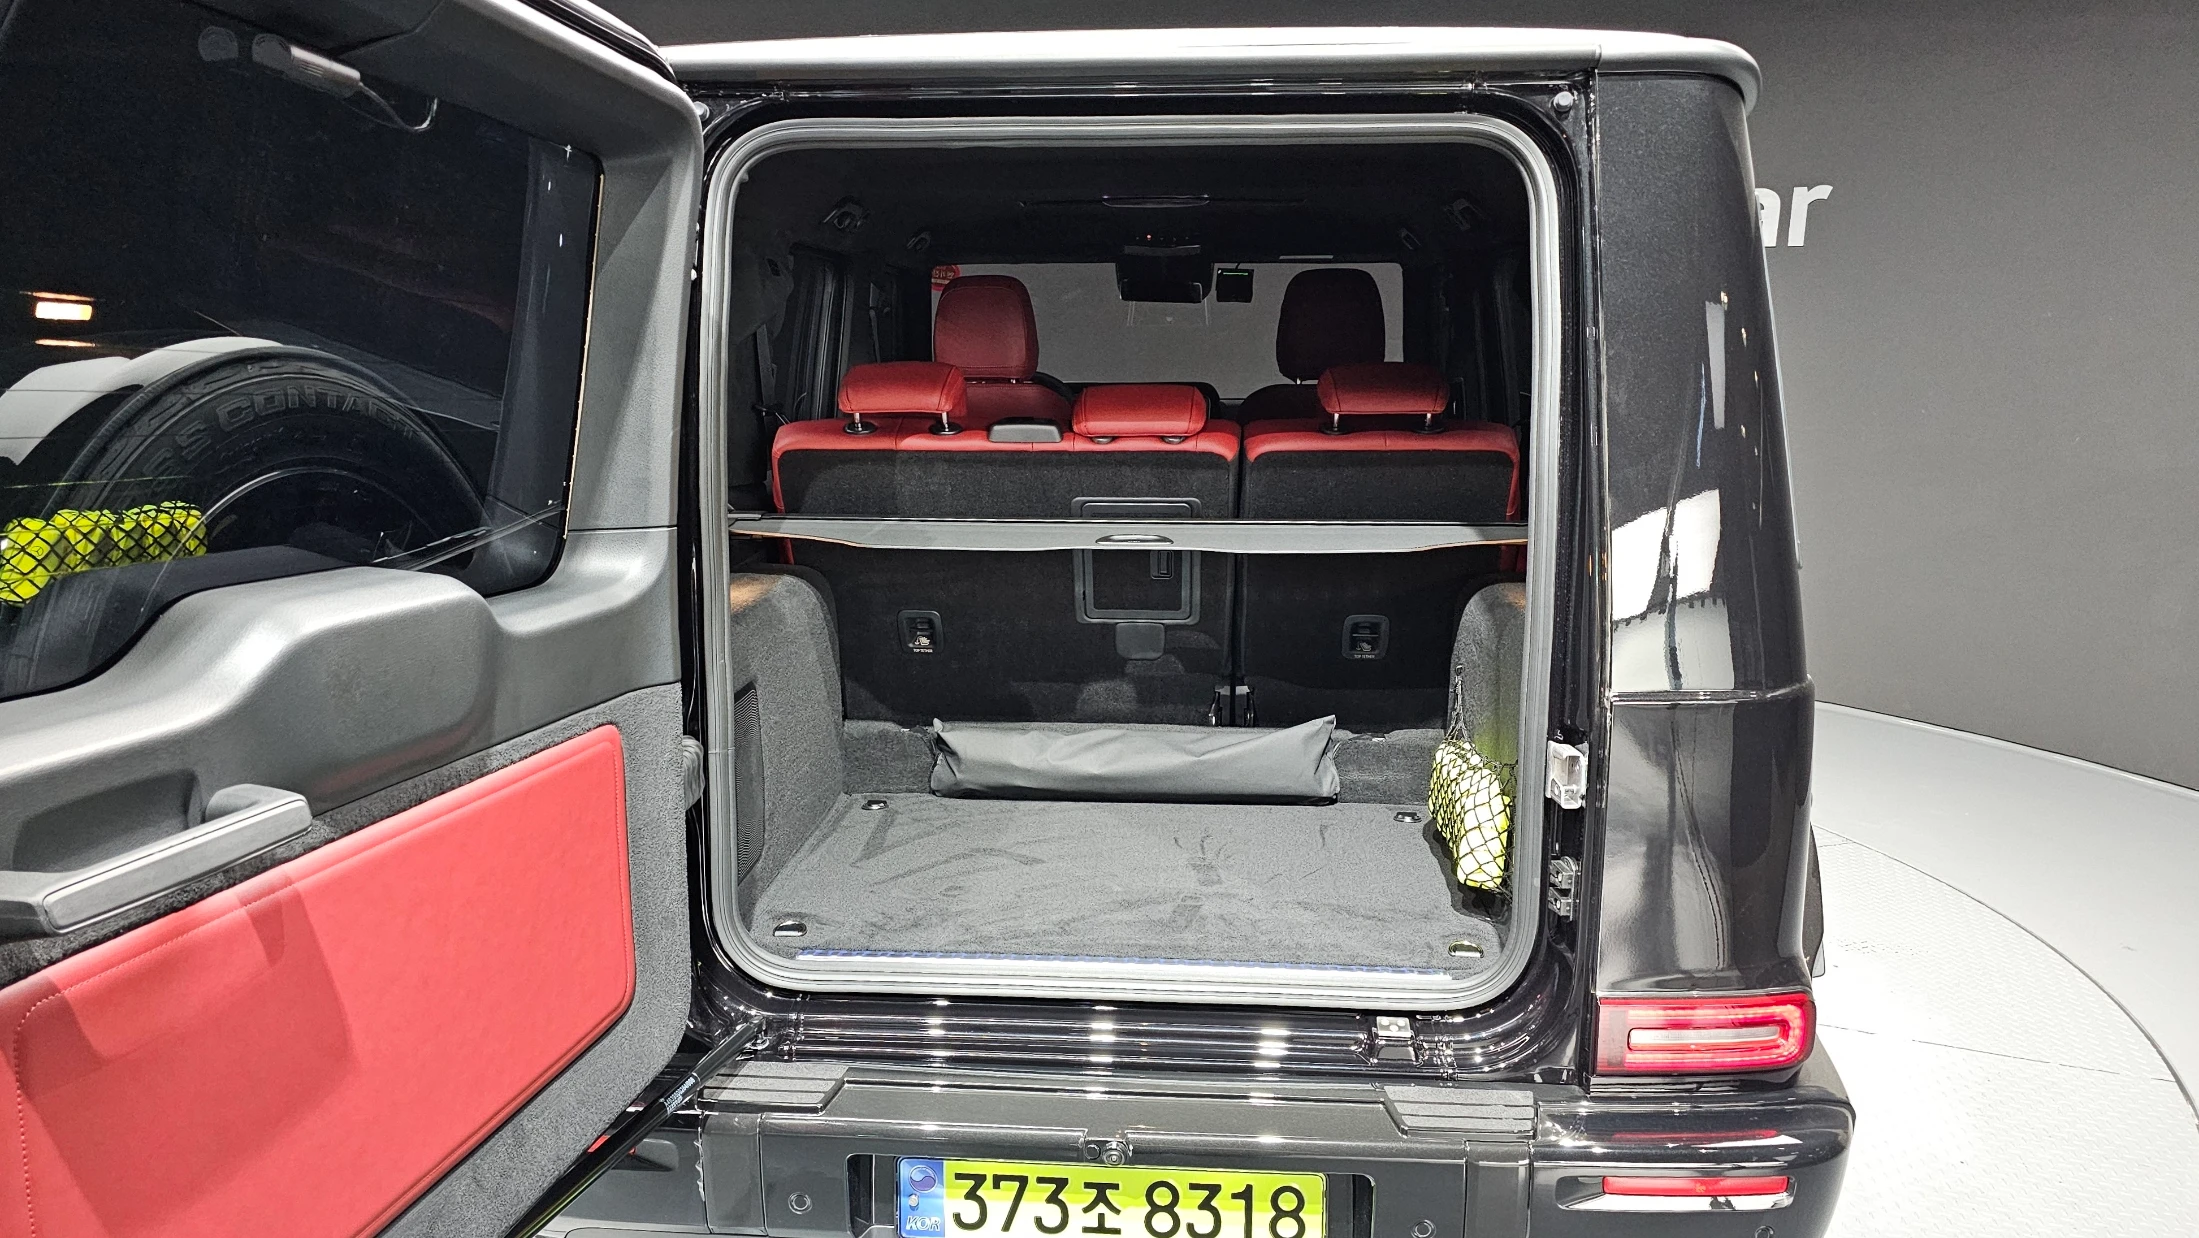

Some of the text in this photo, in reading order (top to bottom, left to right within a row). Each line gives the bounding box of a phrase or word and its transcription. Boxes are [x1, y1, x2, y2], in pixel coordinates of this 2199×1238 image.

[906, 1215, 941, 1232] KOR
[952, 1171, 1306, 1238] 373조 8318
